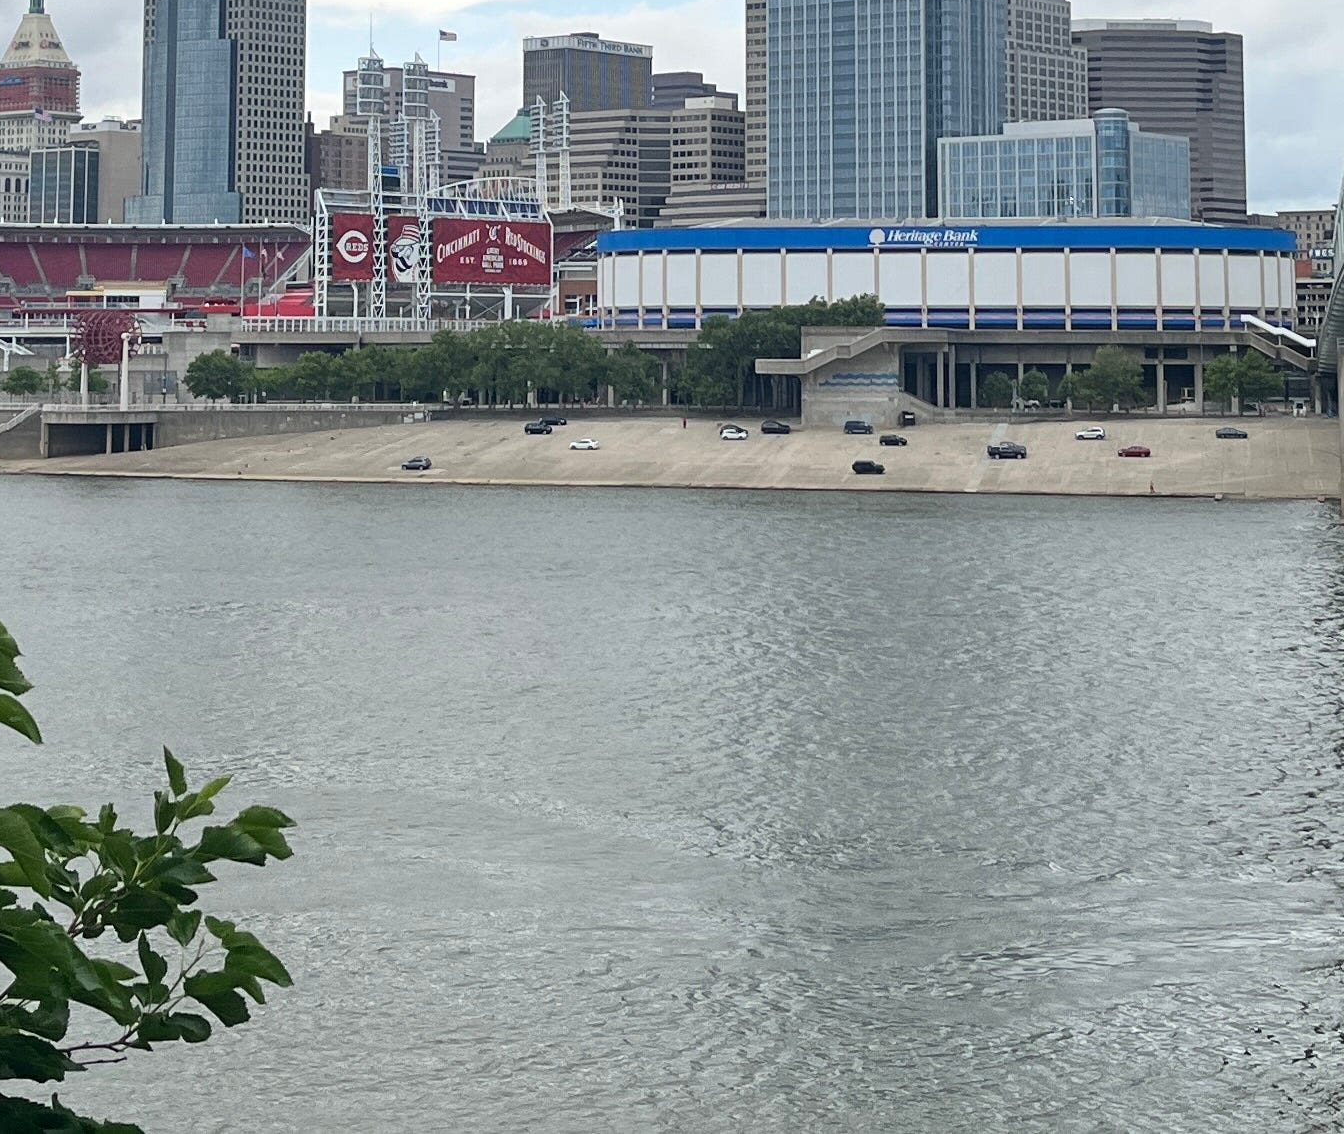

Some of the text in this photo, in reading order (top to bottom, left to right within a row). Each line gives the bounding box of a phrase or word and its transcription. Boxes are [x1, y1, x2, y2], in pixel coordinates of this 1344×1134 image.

[577, 39, 643, 54] FIFTH THIRD BANK
[887, 229, 978, 244] Heritage Bank
[346, 242, 369, 251] REDS
[437, 228, 480, 264] CINCINNATI
[516, 233, 546, 265] STOCKINGS
